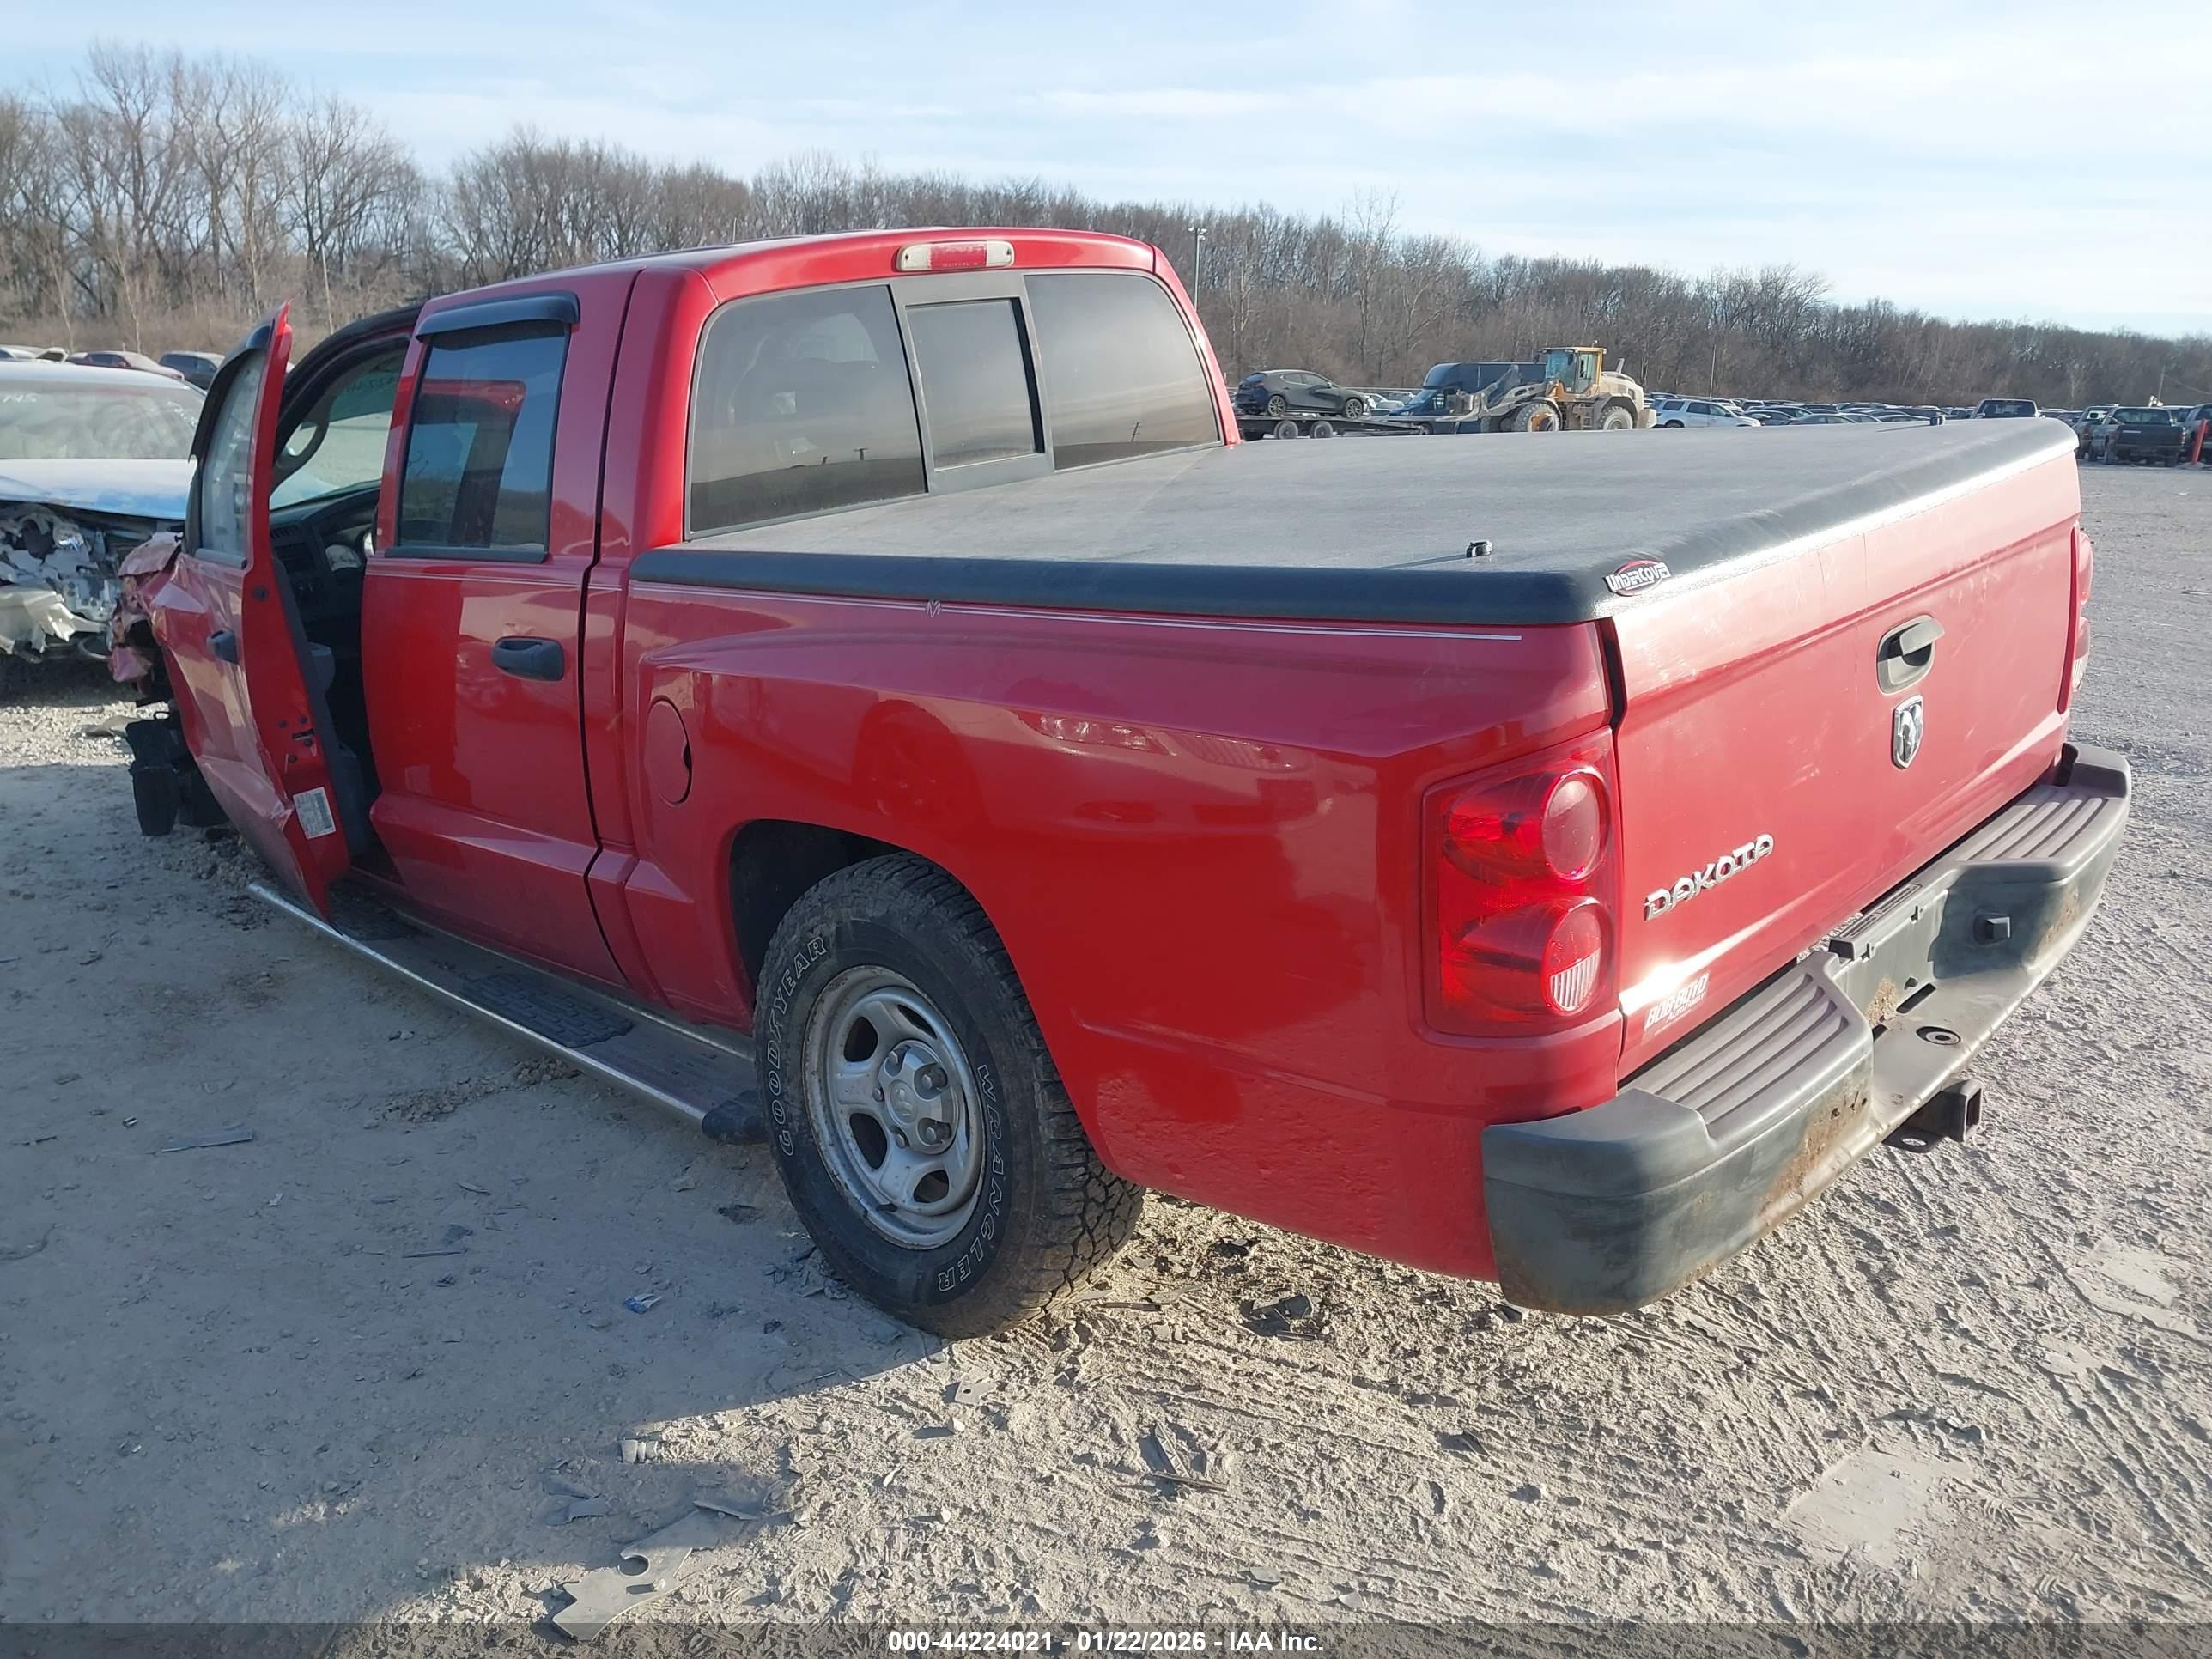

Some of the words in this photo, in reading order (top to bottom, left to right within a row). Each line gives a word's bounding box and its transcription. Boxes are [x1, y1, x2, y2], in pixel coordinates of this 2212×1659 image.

[1604, 562, 1672, 592] UNDERCOVER
[1644, 833, 1775, 921] DAKOTA
[767, 934, 828, 1158] GOODYEAR
[938, 1063, 1006, 1292] WRANGLER
